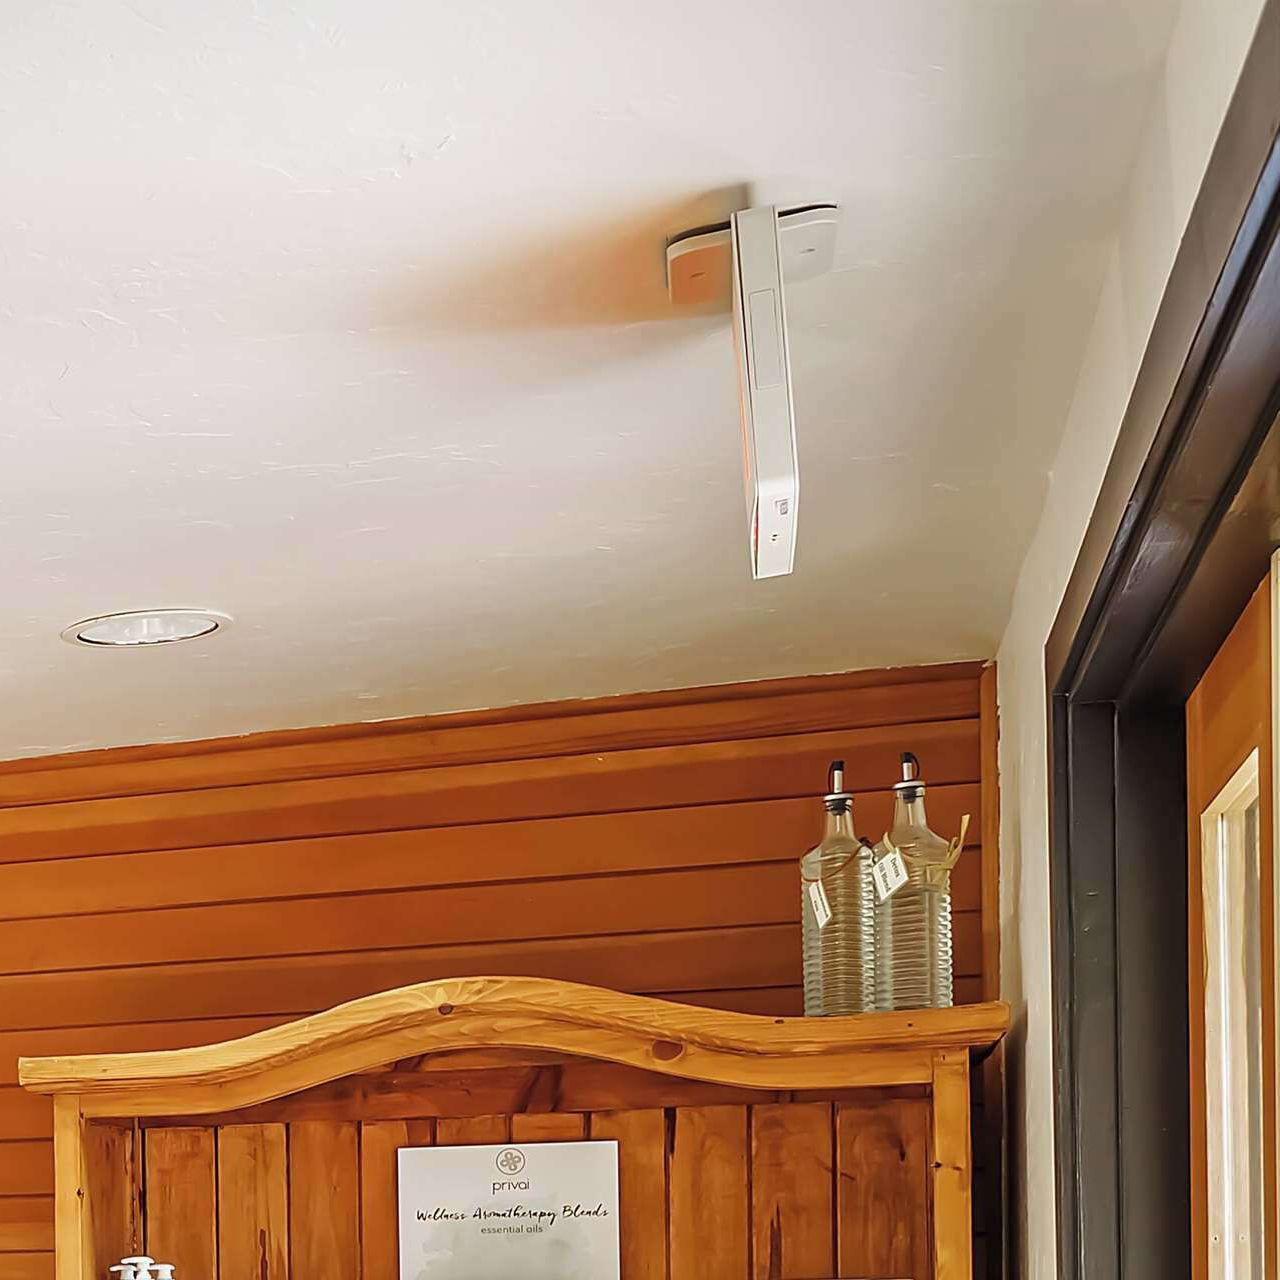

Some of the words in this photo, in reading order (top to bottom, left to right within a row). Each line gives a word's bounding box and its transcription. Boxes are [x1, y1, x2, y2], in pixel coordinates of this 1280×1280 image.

[492, 1178, 530, 1195] privai
[416, 1207, 467, 1221] Wellness
[472, 1205, 557, 1225] Aromatherapy
[562, 1203, 609, 1218] Blends
[480, 1225, 524, 1234] essential
[526, 1225, 544, 1233] oils
